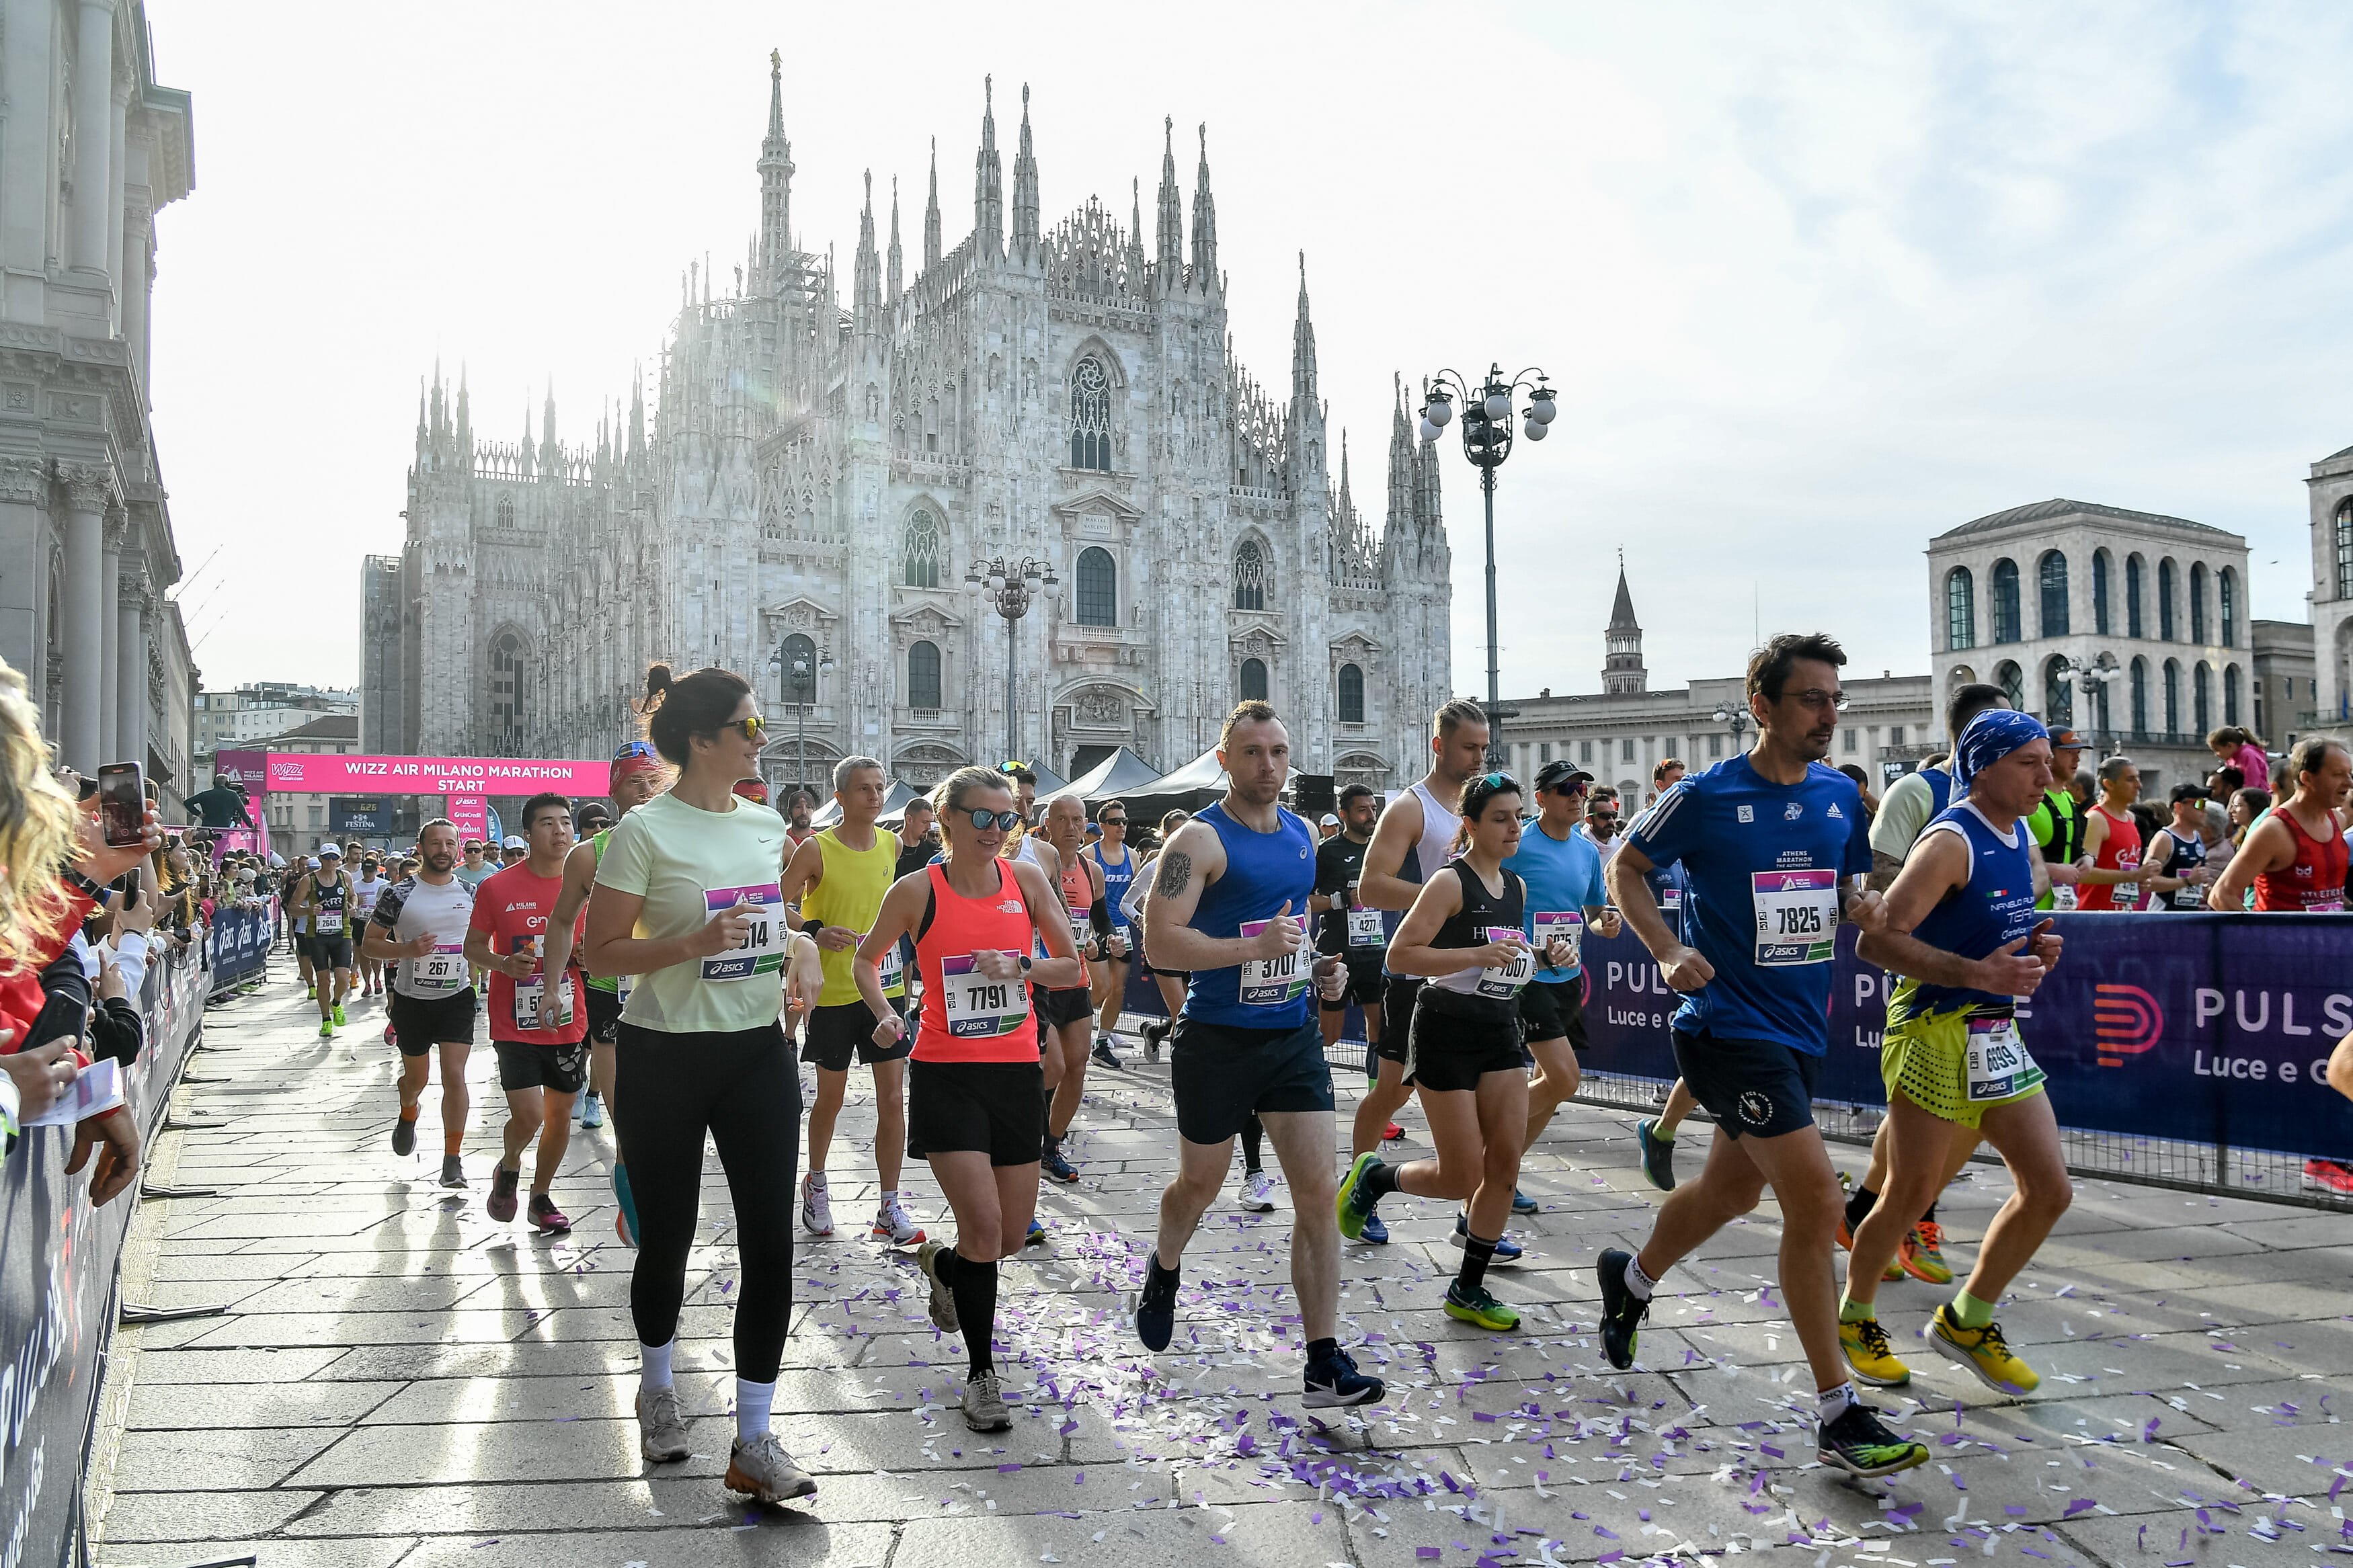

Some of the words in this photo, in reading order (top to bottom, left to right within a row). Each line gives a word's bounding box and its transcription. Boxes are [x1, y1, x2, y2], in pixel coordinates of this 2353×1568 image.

[345, 762, 387, 775] WIZZ
[393, 764, 419, 776] AIR
[424, 764, 483, 777] MILANO
[489, 767, 572, 779] MARATHON
[438, 780, 485, 792] START
[526, 916, 548, 927] en
[1359, 919, 1375, 932] 4277
[1776, 907, 1821, 934] 7825
[1775, 946, 1798, 956] asics
[429, 962, 449, 975] 267
[721, 962, 745, 972] asics
[1262, 952, 1296, 978] 3707
[1607, 961, 1668, 995] PUL
[1258, 989, 1279, 997] asics
[1492, 984, 1508, 993] asics
[967, 984, 1008, 1012] 7791
[1608, 1005, 1646, 1027] Luce
[1652, 1013, 1662, 1028] e
[2195, 987, 2353, 1038] PULS
[966, 1021, 988, 1030] asics
[1856, 1026, 1885, 1048] Lu
[1986, 1045, 2018, 1072] 6699
[2194, 1050, 2267, 1081] Luce
[2278, 1062, 2298, 1083] e
[1987, 1081, 2007, 1092] asics
